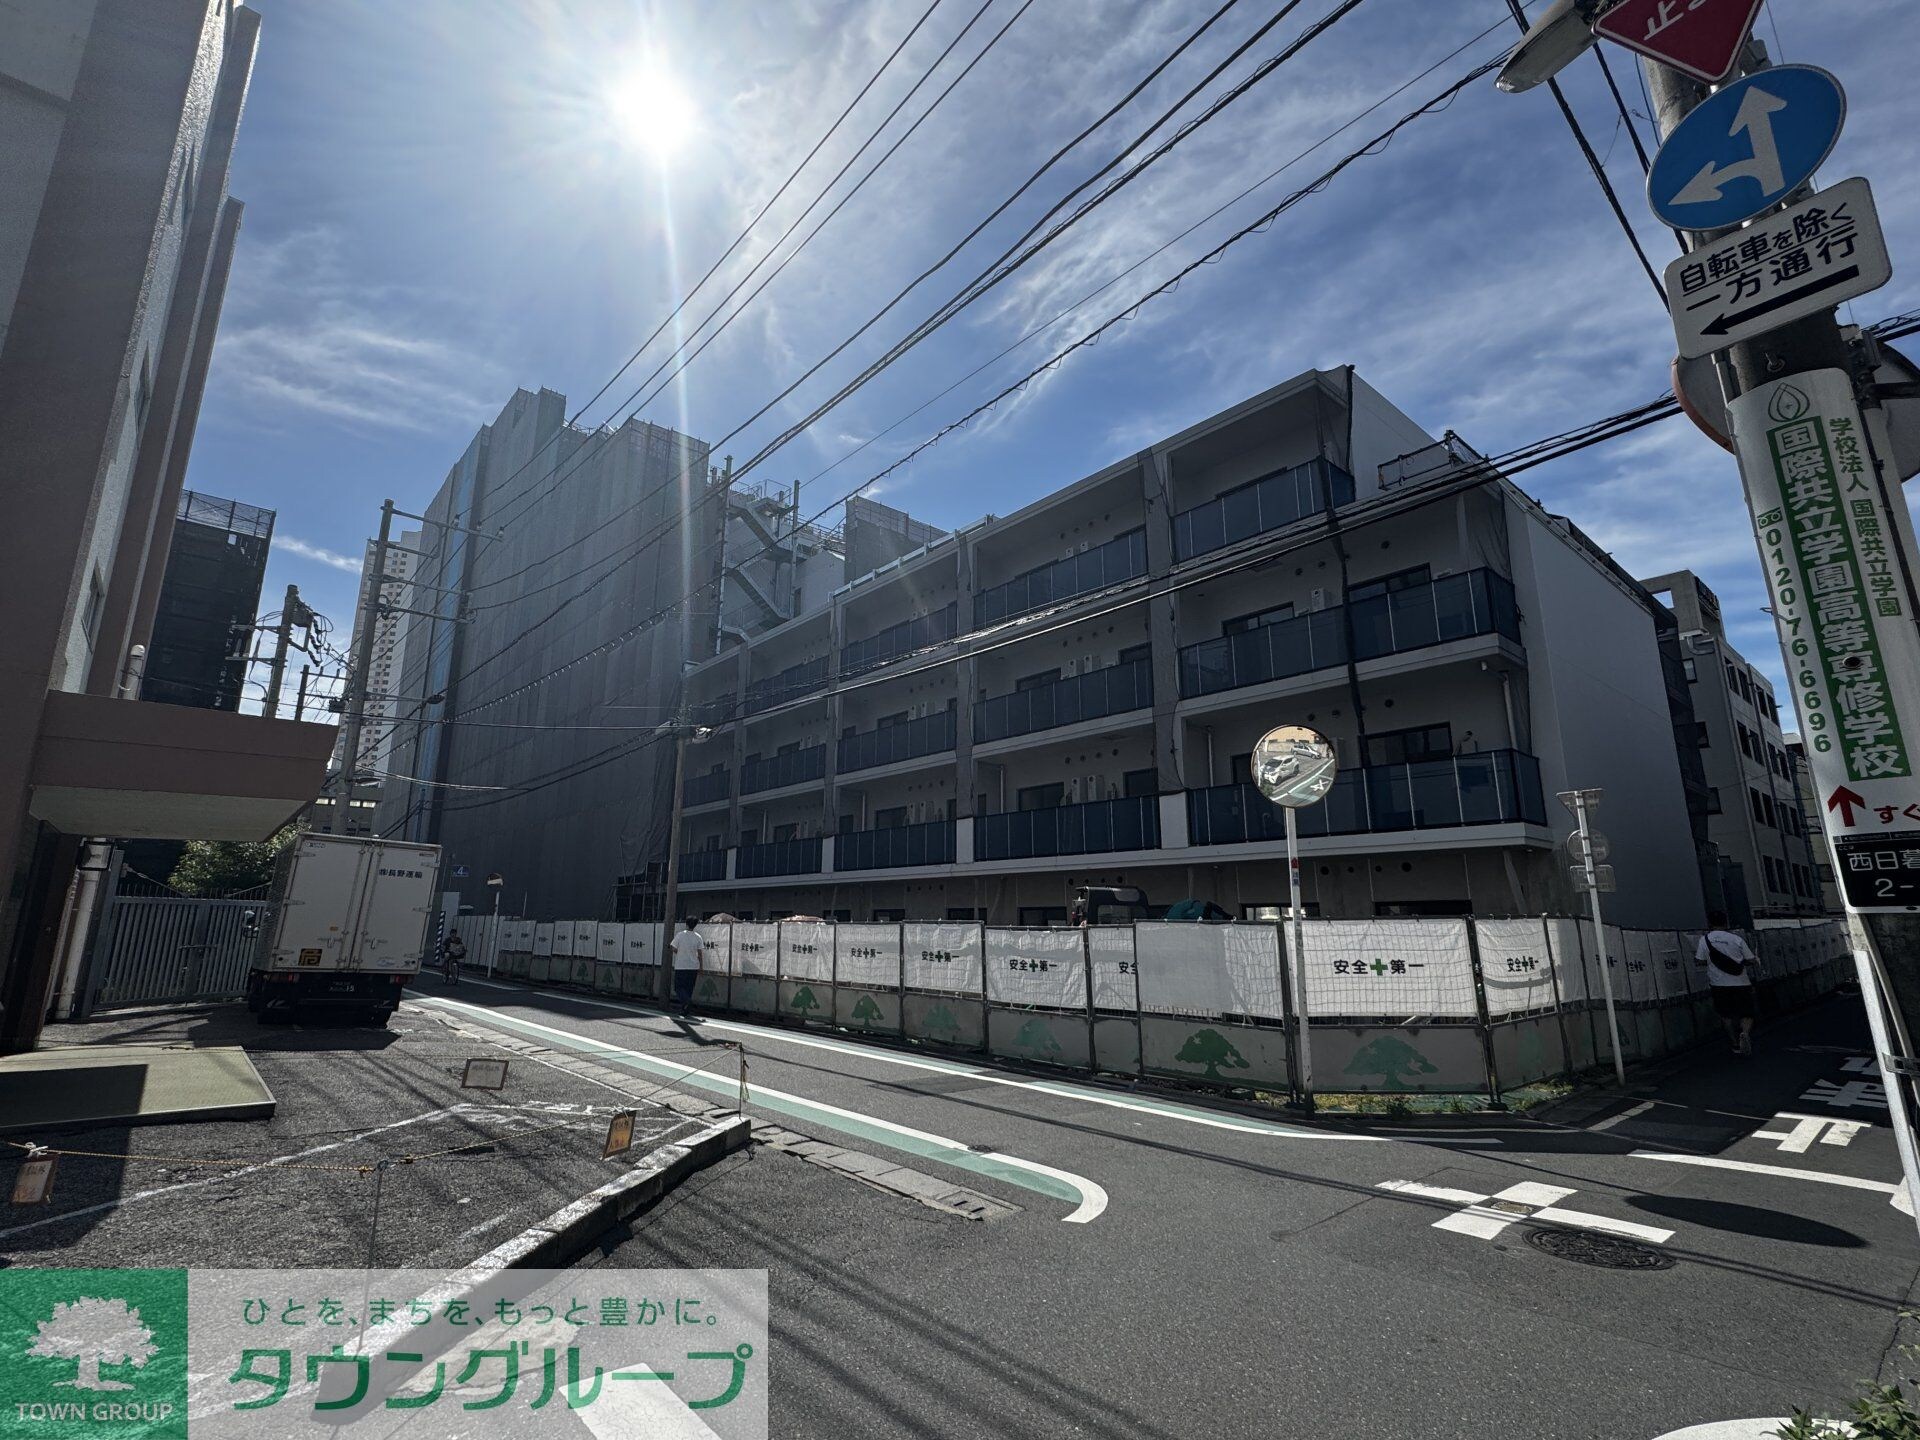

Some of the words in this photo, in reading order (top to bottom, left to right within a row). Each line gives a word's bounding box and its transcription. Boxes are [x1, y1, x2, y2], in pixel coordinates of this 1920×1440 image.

[1679, 202, 1852, 293] 自転車を除く
[1686, 225, 1859, 312] 一方通行
[1774, 420, 1905, 778] 国際共立学園高等専修学校
[1829, 417, 1869, 493] 学校法人
[1850, 498, 1902, 617] 国際共立学園
[1765, 528, 1832, 753] 0120-76-6696
